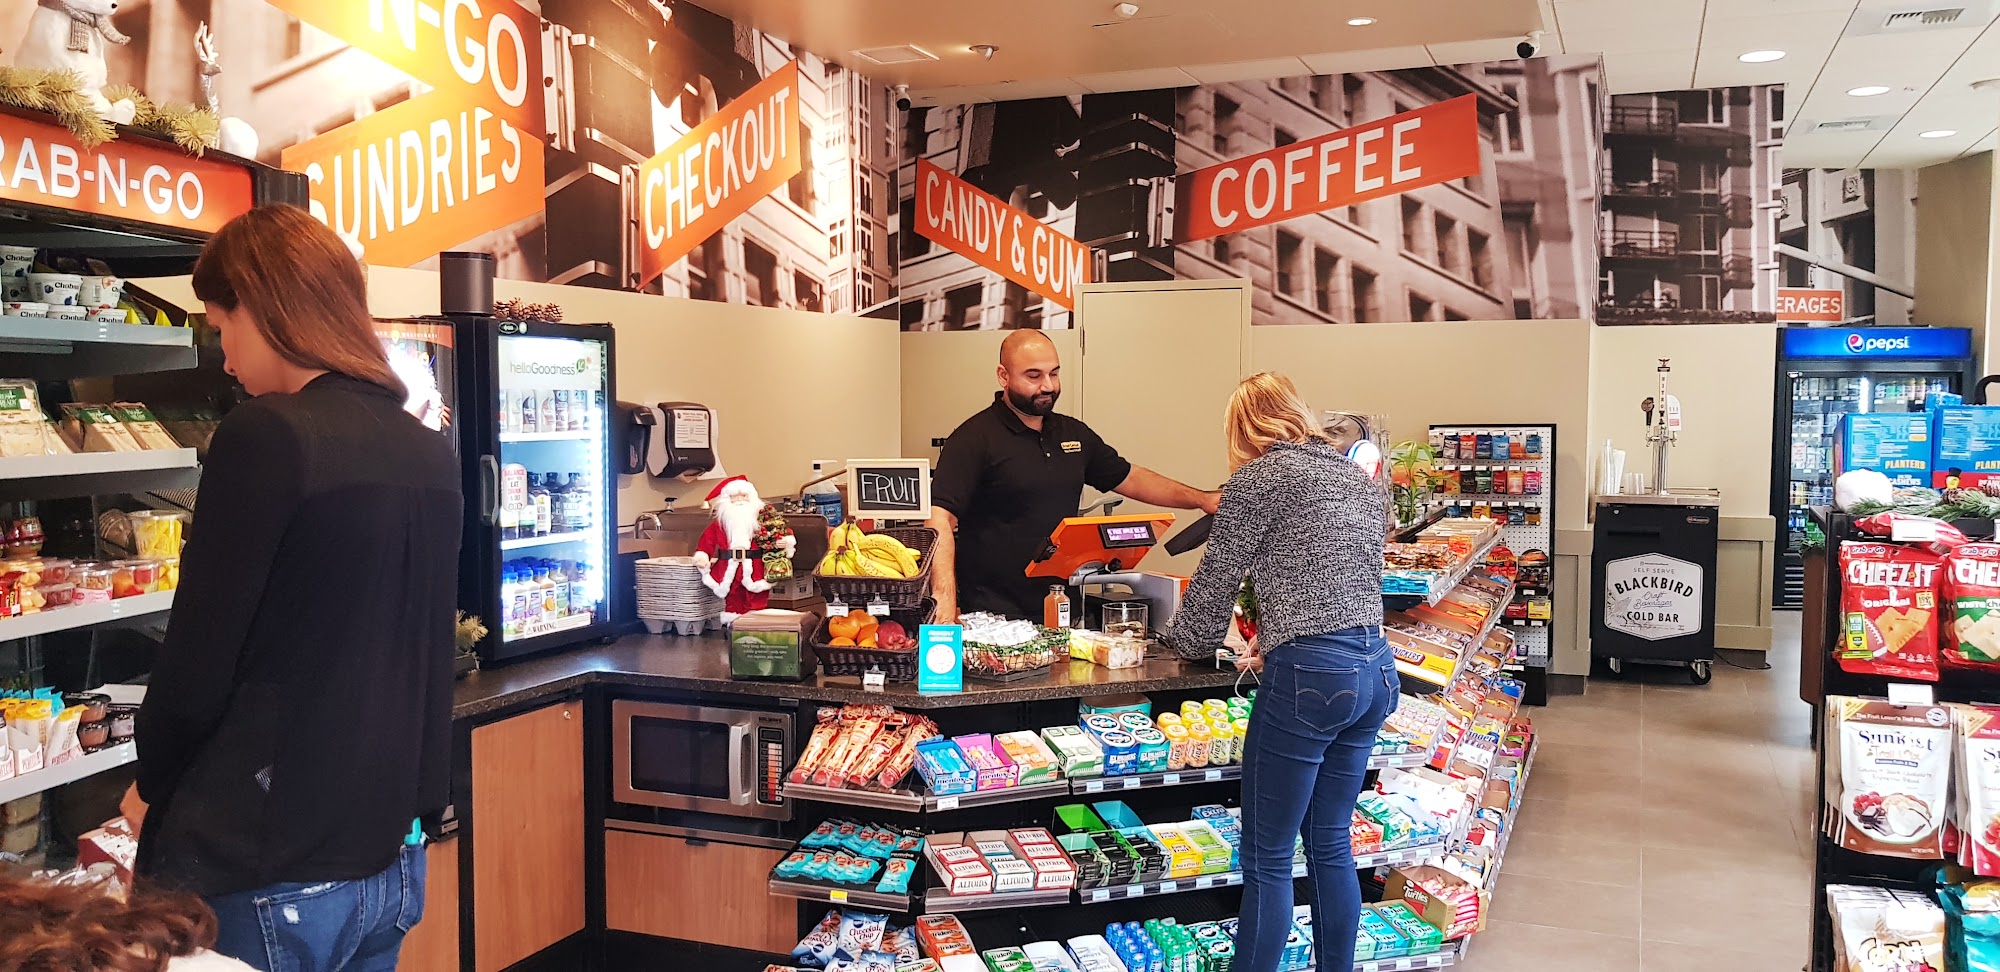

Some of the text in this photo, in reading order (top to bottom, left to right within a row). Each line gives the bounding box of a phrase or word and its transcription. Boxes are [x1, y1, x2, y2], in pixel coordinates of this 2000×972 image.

[644, 85, 791, 251] CHECKOUT
[1209, 116, 1422, 228] COFFEE
[0, 135, 205, 220] AB-N-GO
[305, 106, 522, 241] SUNDRIES
[925, 170, 1087, 297] CANDY & GUM
[1865, 335, 1910, 351] pepsi
[1884, 460, 1926, 470] PLANTERS
[860, 472, 920, 504] FRUIT
[1955, 558, 2000, 587] CHE
[1614, 576, 1693, 597] BLACKBIRD
[1626, 611, 1679, 623] COLD BAR
[1017, 832, 1046, 840] ALTOIDS
[945, 848, 973, 858] ALTOIDS
[953, 863, 982, 872] ALTOIDS
[997, 862, 1026, 870] ALTOIDS
[1037, 860, 1066, 868] ALTOIDS
[957, 879, 989, 889] ALTOIDS
[1000, 877, 1030, 887] ALTOIDS
[1041, 874, 1071, 884] ALTOIDS
[1402, 884, 1429, 904] Turtles
[849, 923, 883, 937] Chocolate
[932, 929, 954, 937] Trident
[859, 932, 874, 941] Chip
[940, 943, 961, 951] Trident
[991, 951, 1013, 961] Trident
[999, 960, 1022, 969] Trident
